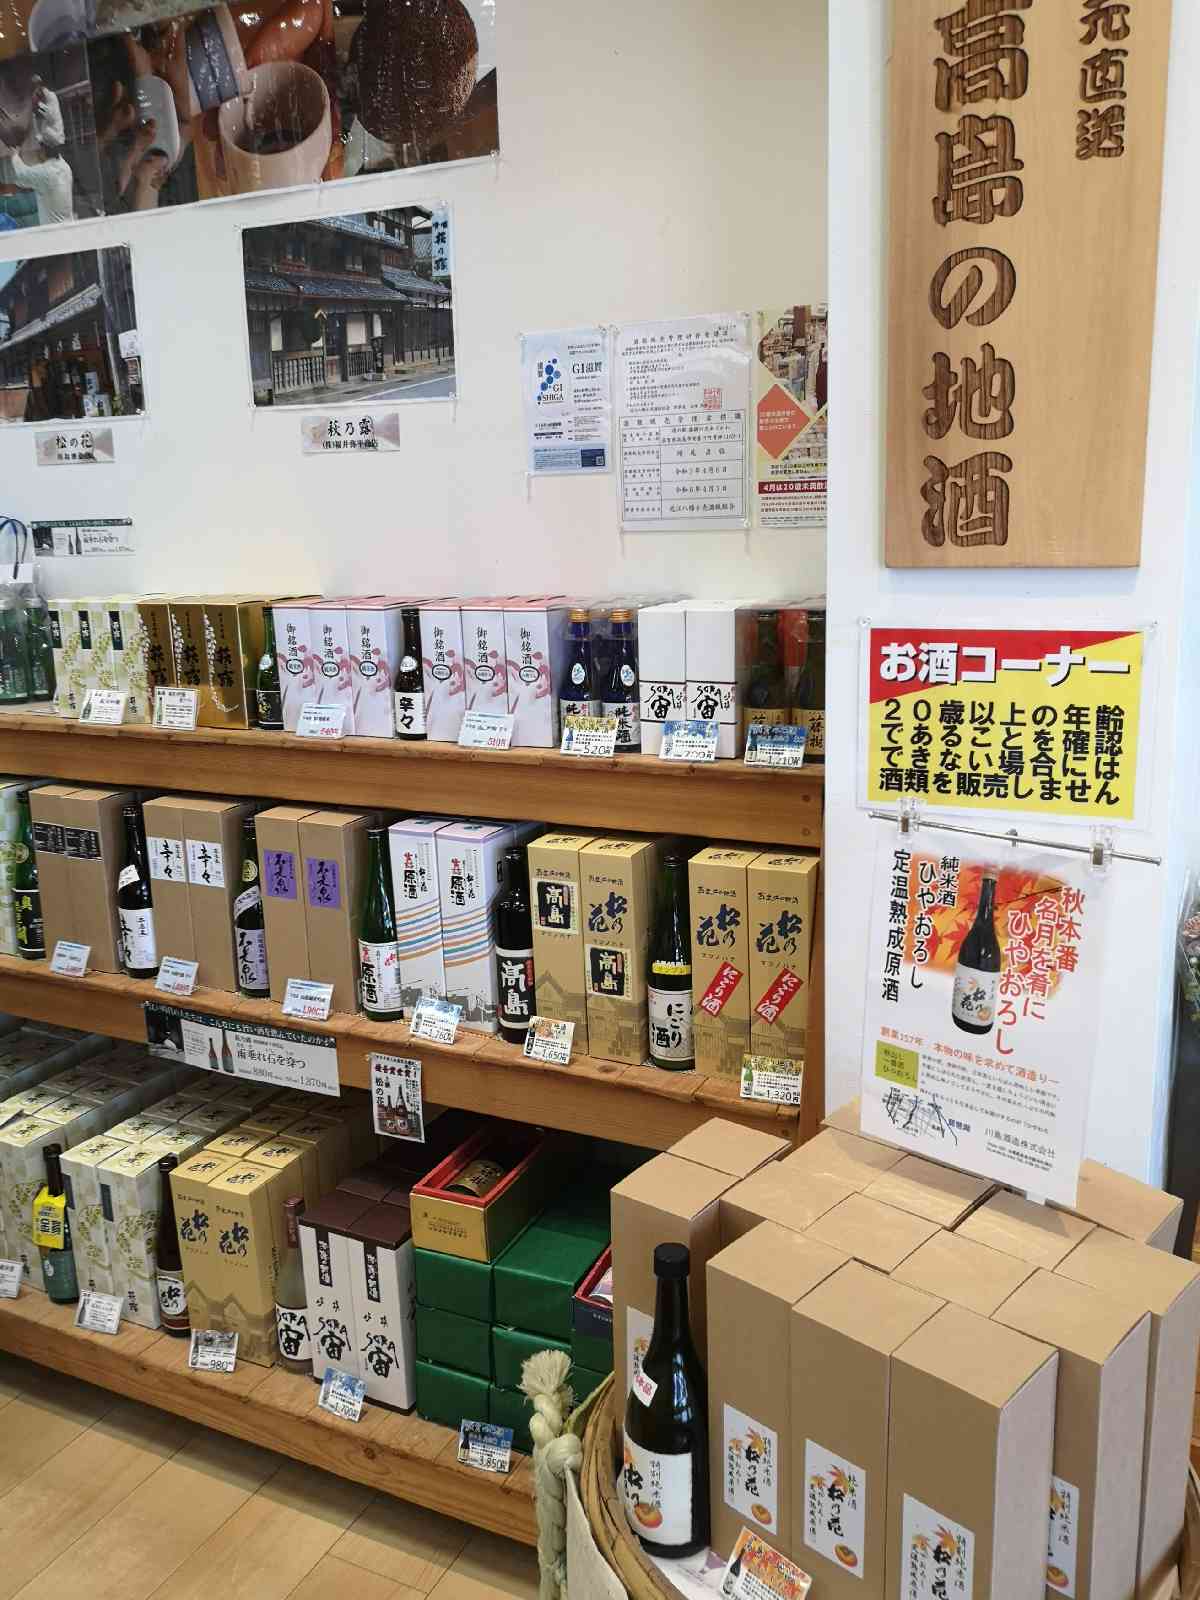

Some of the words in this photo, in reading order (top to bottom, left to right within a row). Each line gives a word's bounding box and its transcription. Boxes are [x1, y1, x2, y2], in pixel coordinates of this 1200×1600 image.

[879, 641, 1131, 687] お酒コーナー
[879, 722, 1124, 757] であることを確認
[883, 697, 1125, 732] 20歳以上の年齢
[878, 767, 1121, 806] 酒類を販売しません
[880, 745, 1121, 781] できない場合には
[937, 855, 960, 908] 純米酒
[881, 848, 912, 1003] 定温熟成原酒
[910, 861, 937, 989] ひやおろし
[1055, 886, 1086, 973] 秋本番
[995, 911, 1034, 1055] ひやおろし
[1022, 895, 1062, 1020] 名月を肴に
